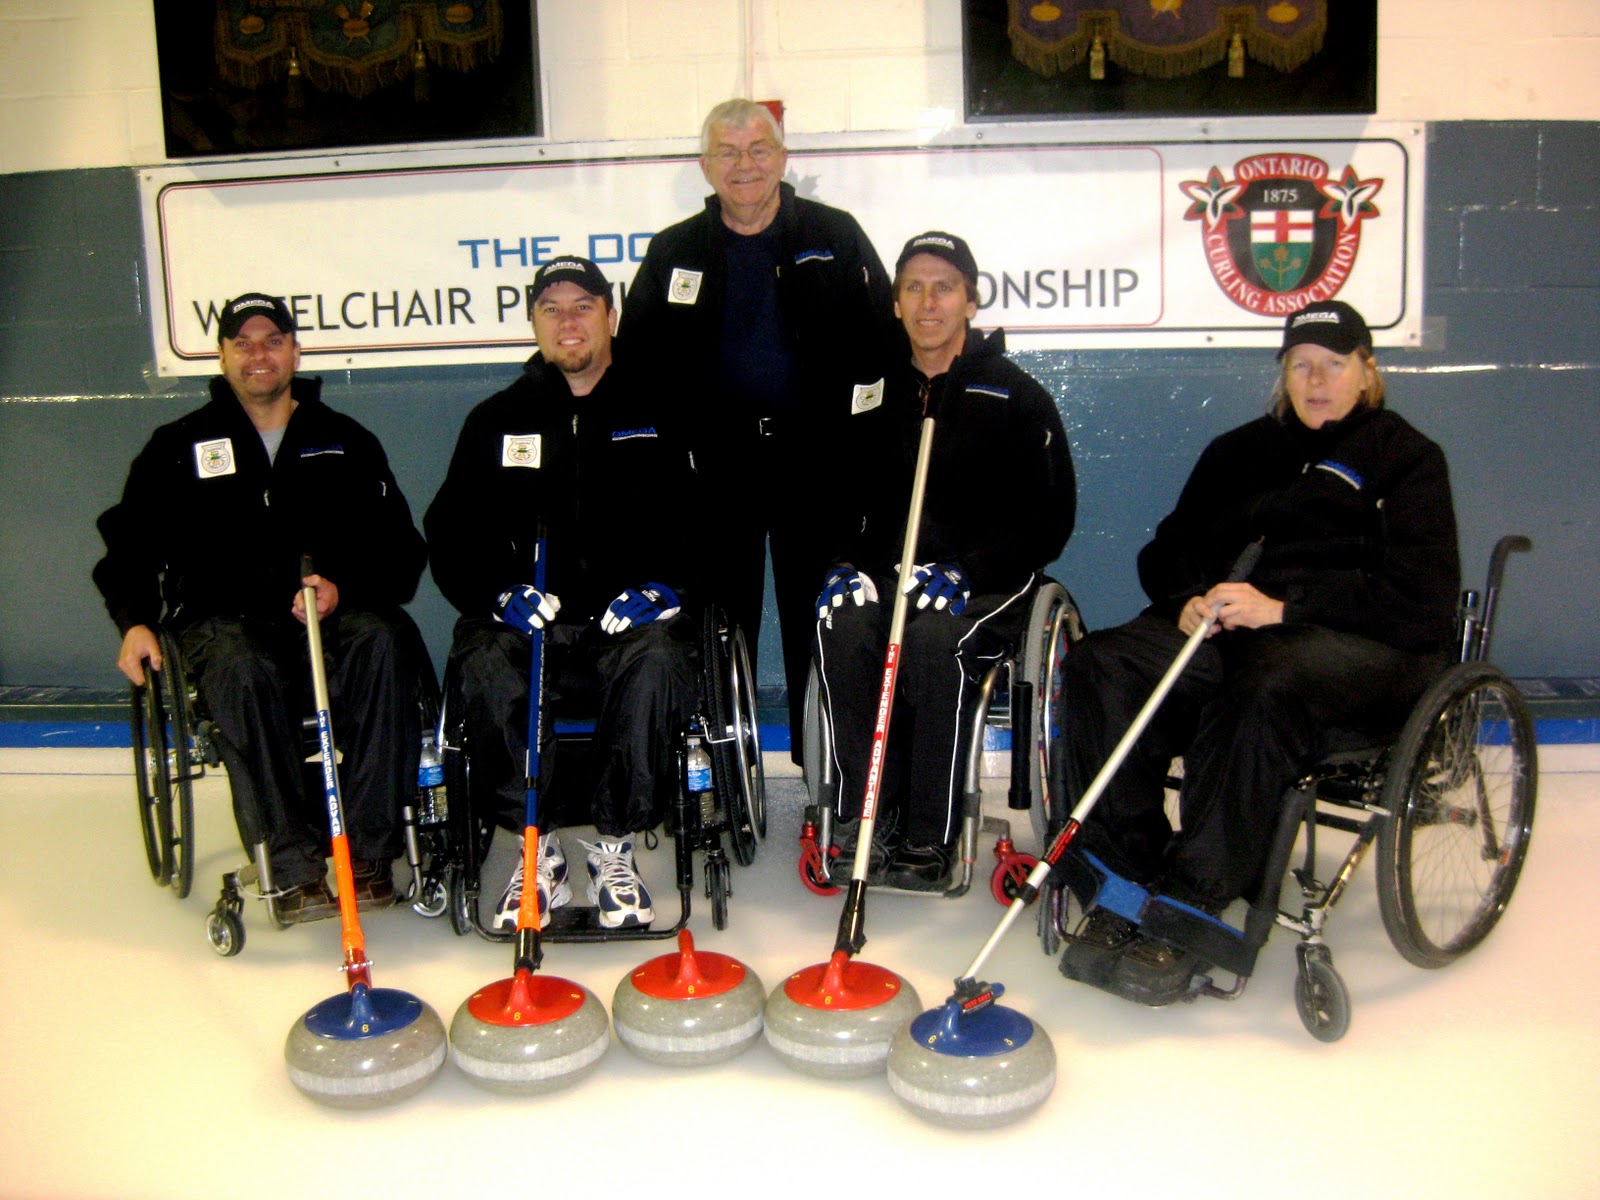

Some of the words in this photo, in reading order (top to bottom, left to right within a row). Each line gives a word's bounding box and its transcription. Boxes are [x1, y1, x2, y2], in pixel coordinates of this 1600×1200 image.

[1239, 156, 1325, 182] ONTARIO
[1262, 188, 1299, 204] 1875
[458, 236, 560, 269] THE
[546, 260, 586, 276] OMEGA
[1206, 233, 1262, 309] CURLING
[1262, 230, 1357, 313] ASSOCIATION
[192, 286, 475, 337] WELCHAIR
[976, 269, 1140, 311] ONSHIP
[1293, 311, 1340, 326] OMEGA
[876, 669, 892, 733] EXTENDER
[321, 731, 335, 789] EXTENDER
[863, 739, 881, 818] ADVANTAGE
[687, 985, 695, 994] 6
[824, 995, 832, 1005] 6
[514, 1011, 521, 1021] 6
